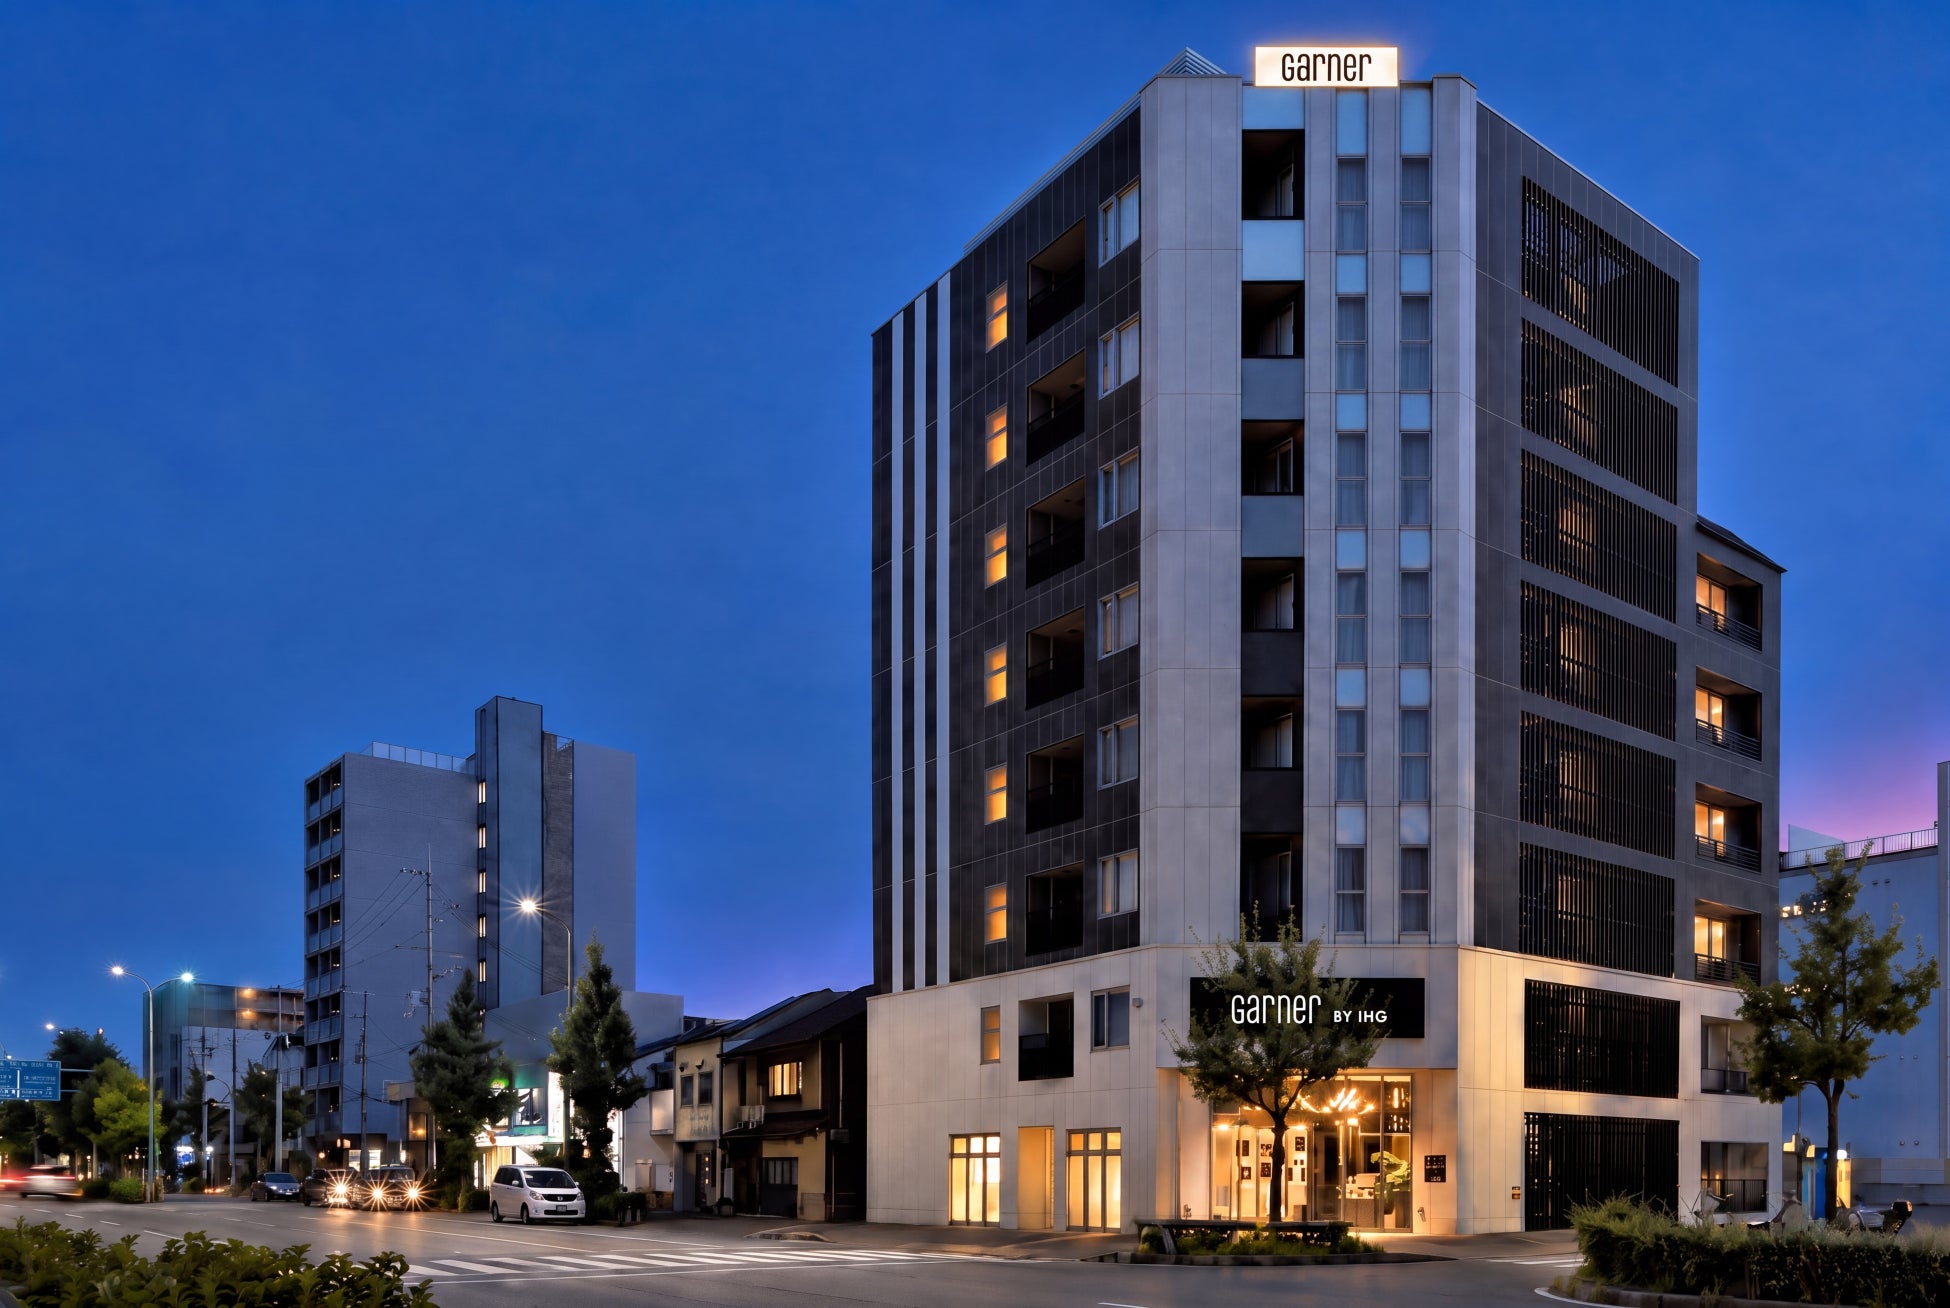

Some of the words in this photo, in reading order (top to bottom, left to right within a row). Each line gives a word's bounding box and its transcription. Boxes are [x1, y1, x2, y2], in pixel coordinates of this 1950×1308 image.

[1281, 53, 1372, 82] Garner
[1231, 994, 1322, 1024] Garner
[1333, 1010, 1353, 1023] BY
[1358, 1010, 1388, 1023] IHG
